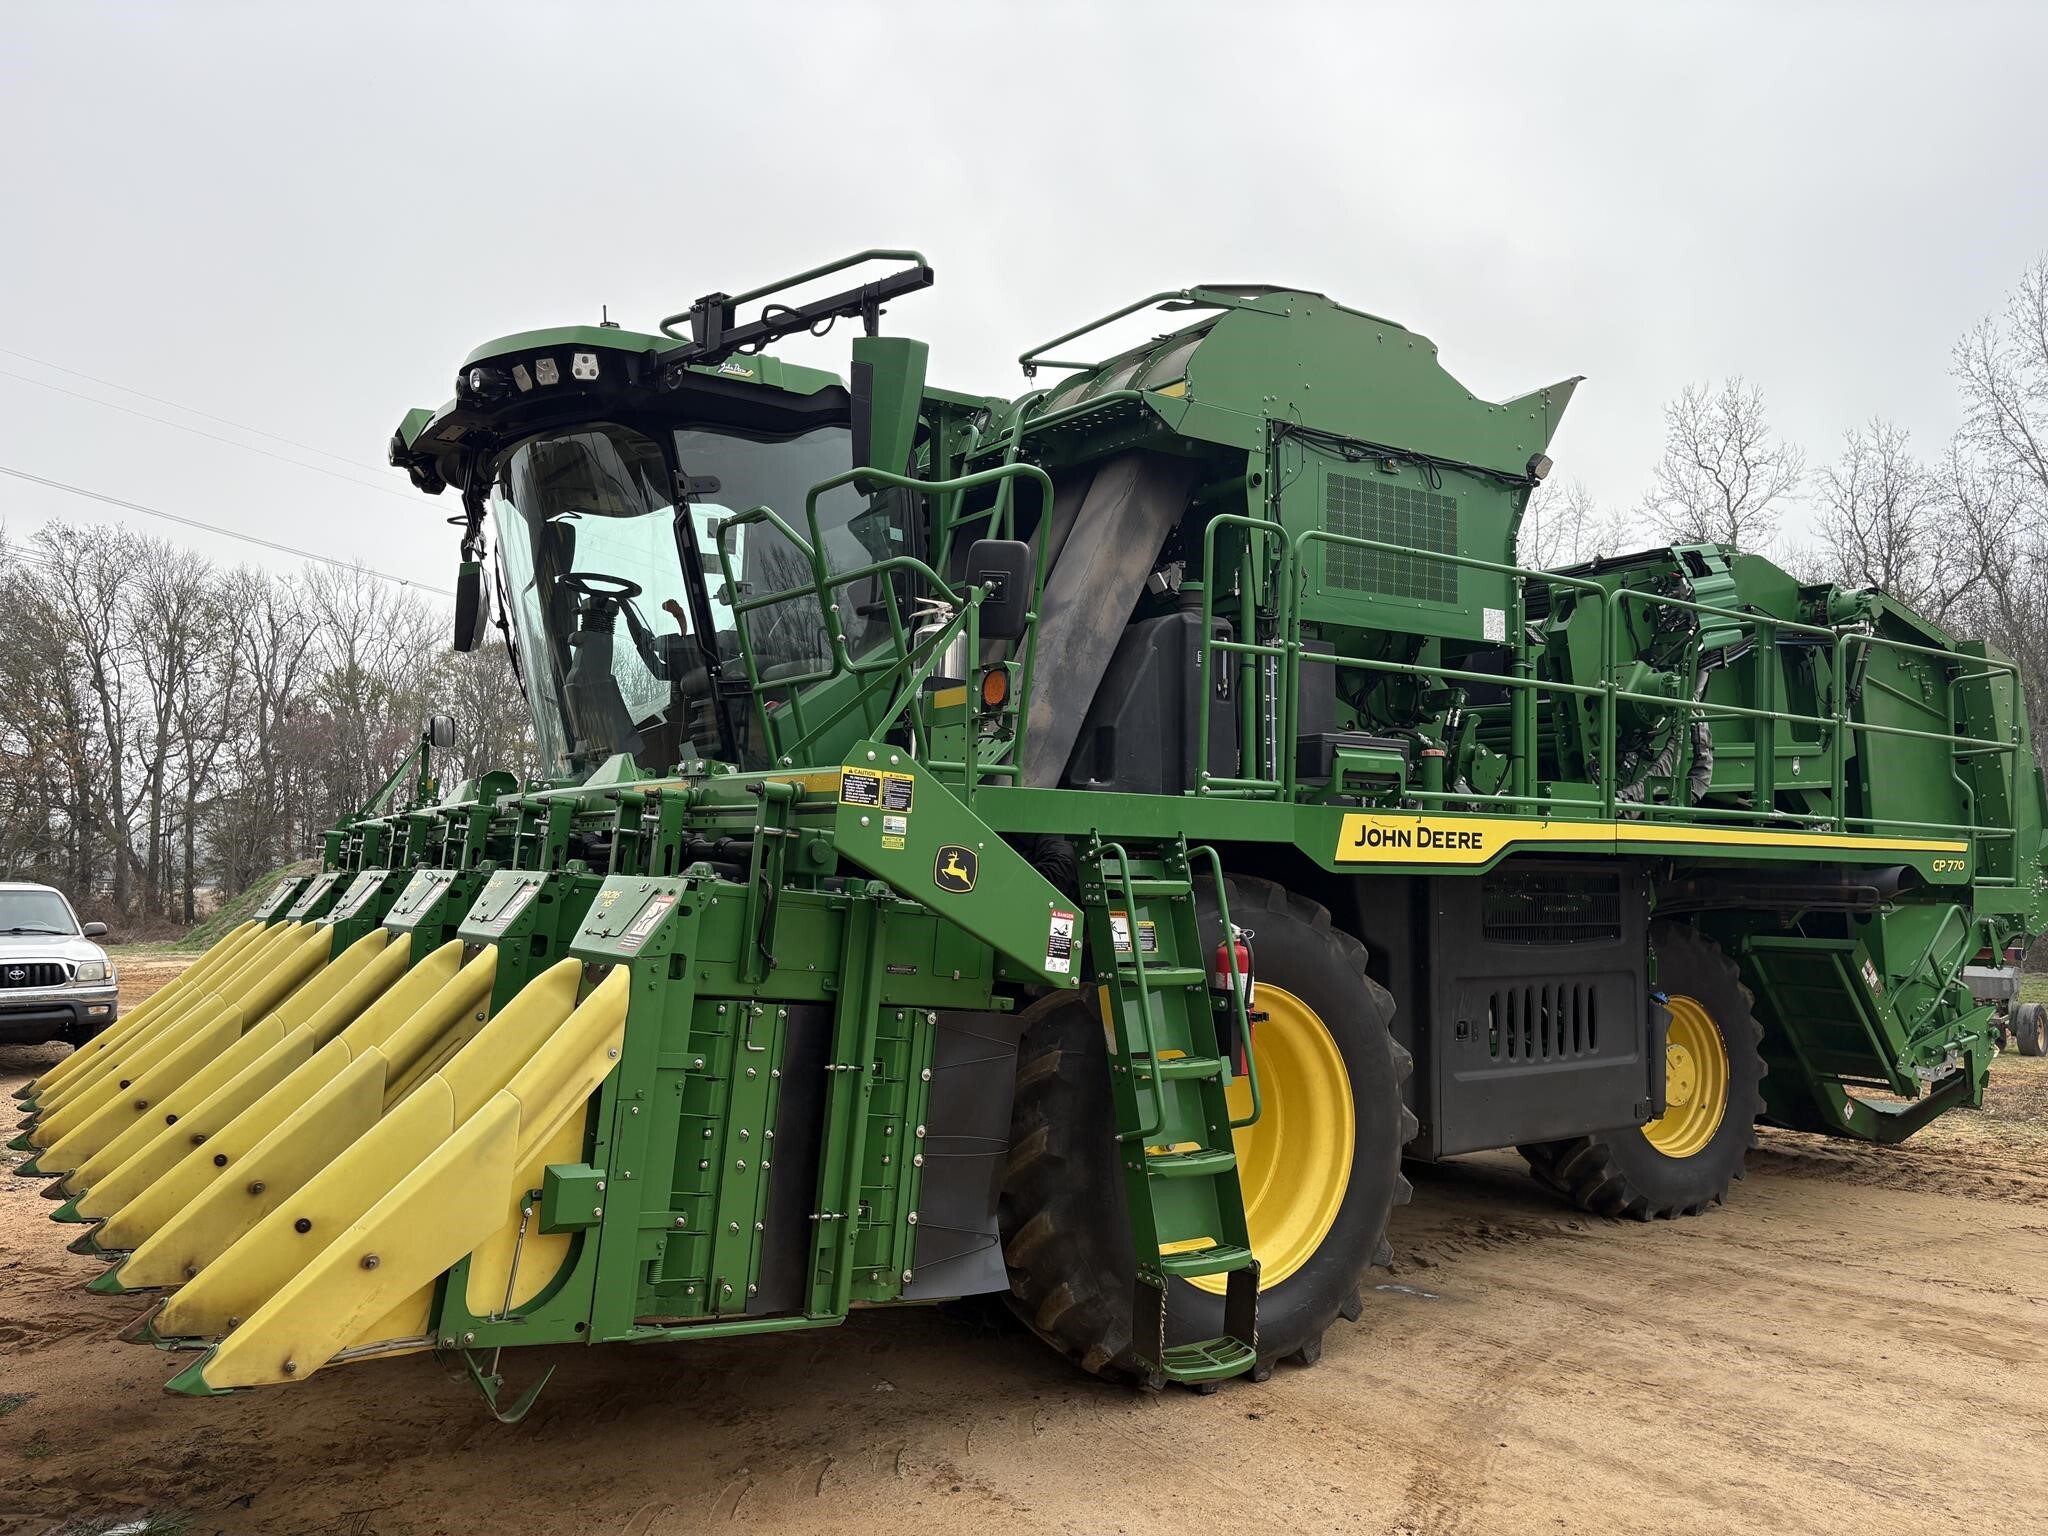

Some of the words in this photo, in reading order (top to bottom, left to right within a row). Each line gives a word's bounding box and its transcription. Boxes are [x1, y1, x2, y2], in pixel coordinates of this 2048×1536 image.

[854, 769, 876, 777] CAUTION
[1355, 825, 1412, 847] JOHN
[1417, 827, 1483, 849] DEERE
[1933, 859, 1946, 872] CP
[1947, 860, 1965, 872] 770
